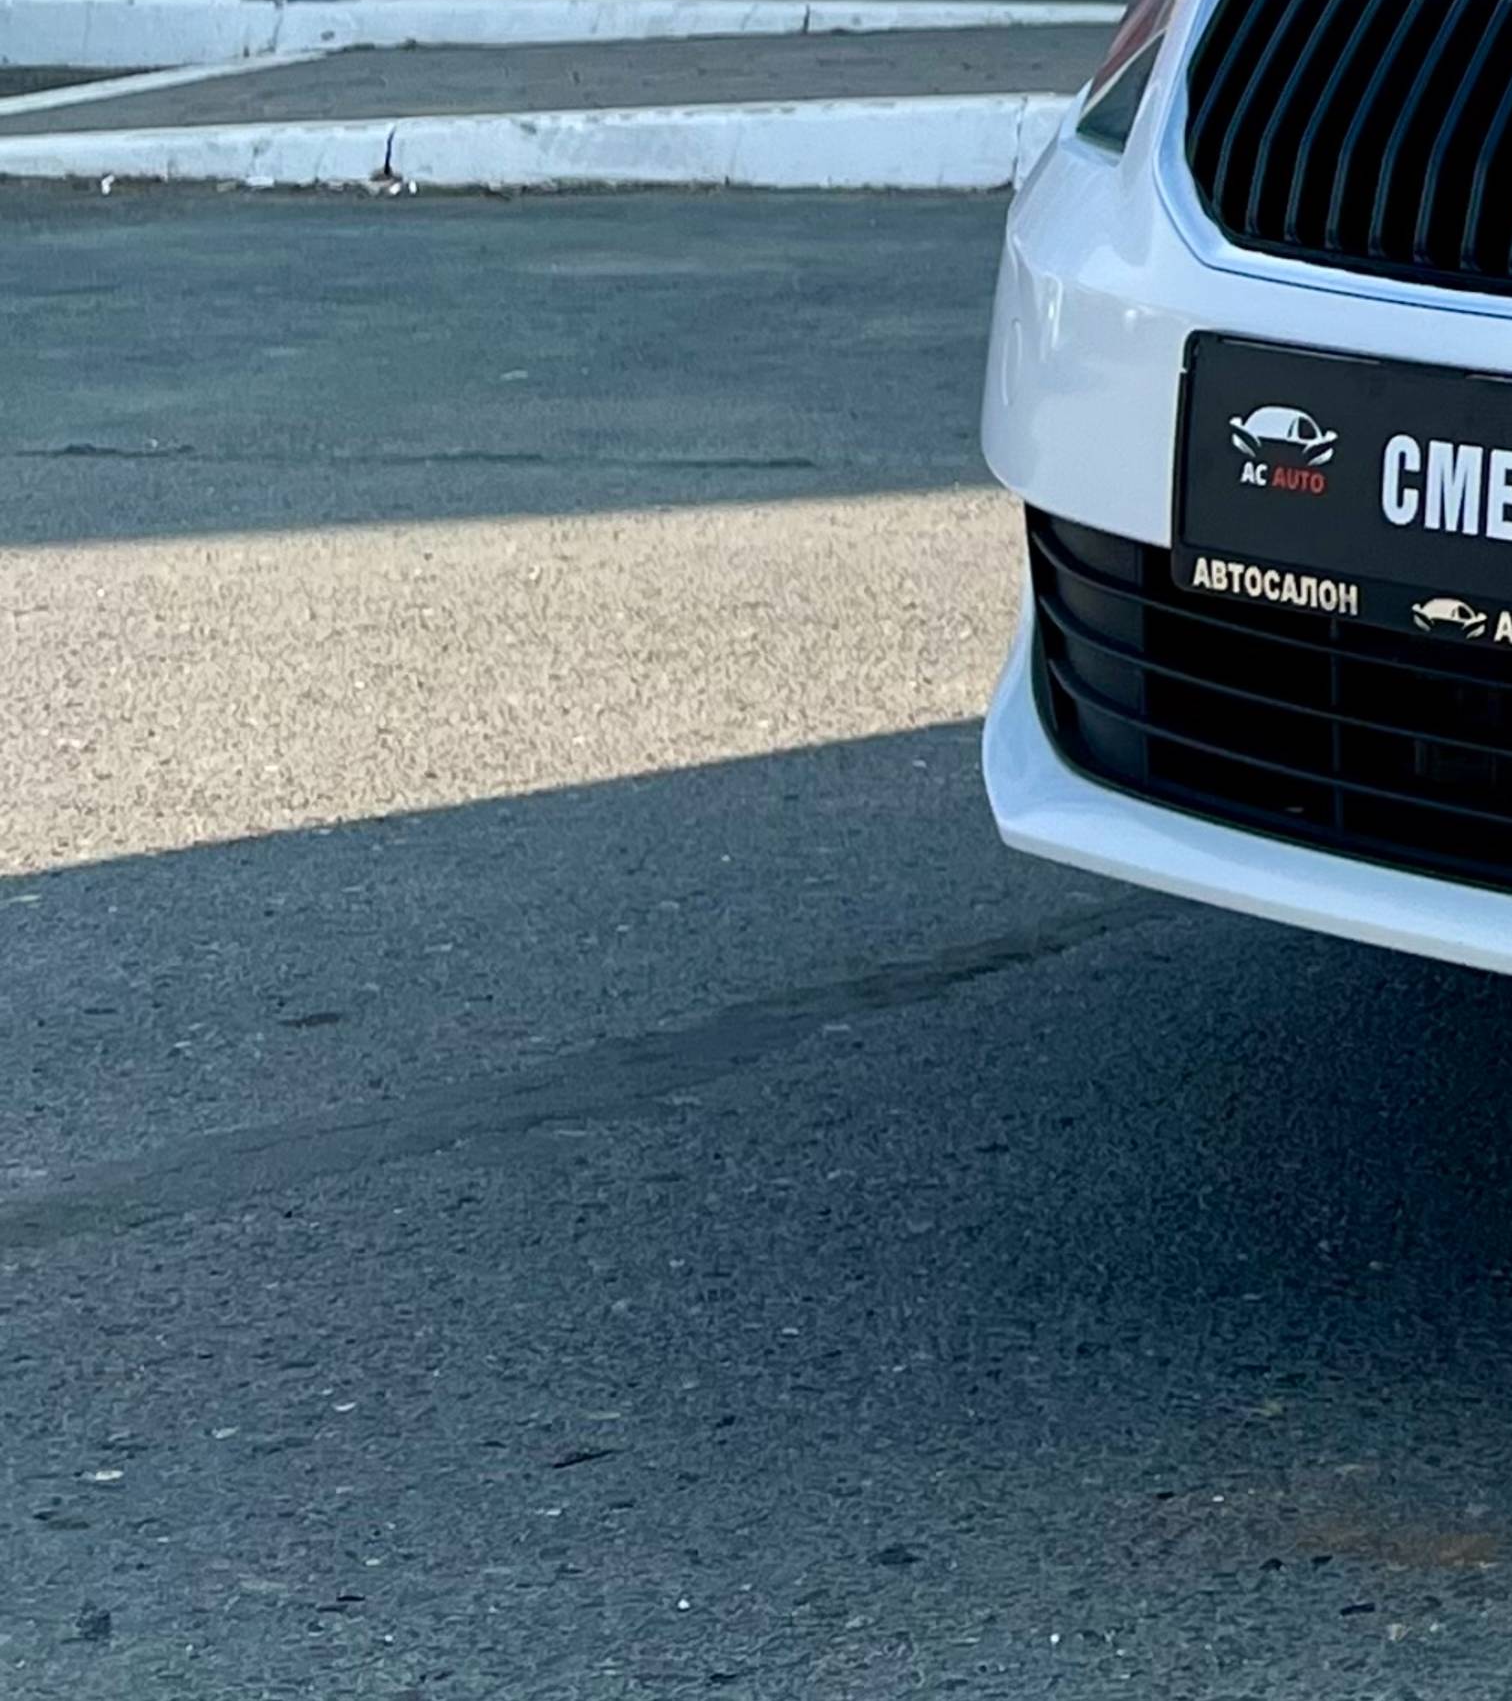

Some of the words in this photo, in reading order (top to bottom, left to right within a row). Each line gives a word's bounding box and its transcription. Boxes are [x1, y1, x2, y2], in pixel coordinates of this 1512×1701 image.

[1240, 461, 1268, 488] AC
[1272, 465, 1327, 496] AUTO
[1192, 555, 1360, 617] АВТОСАЛОН
